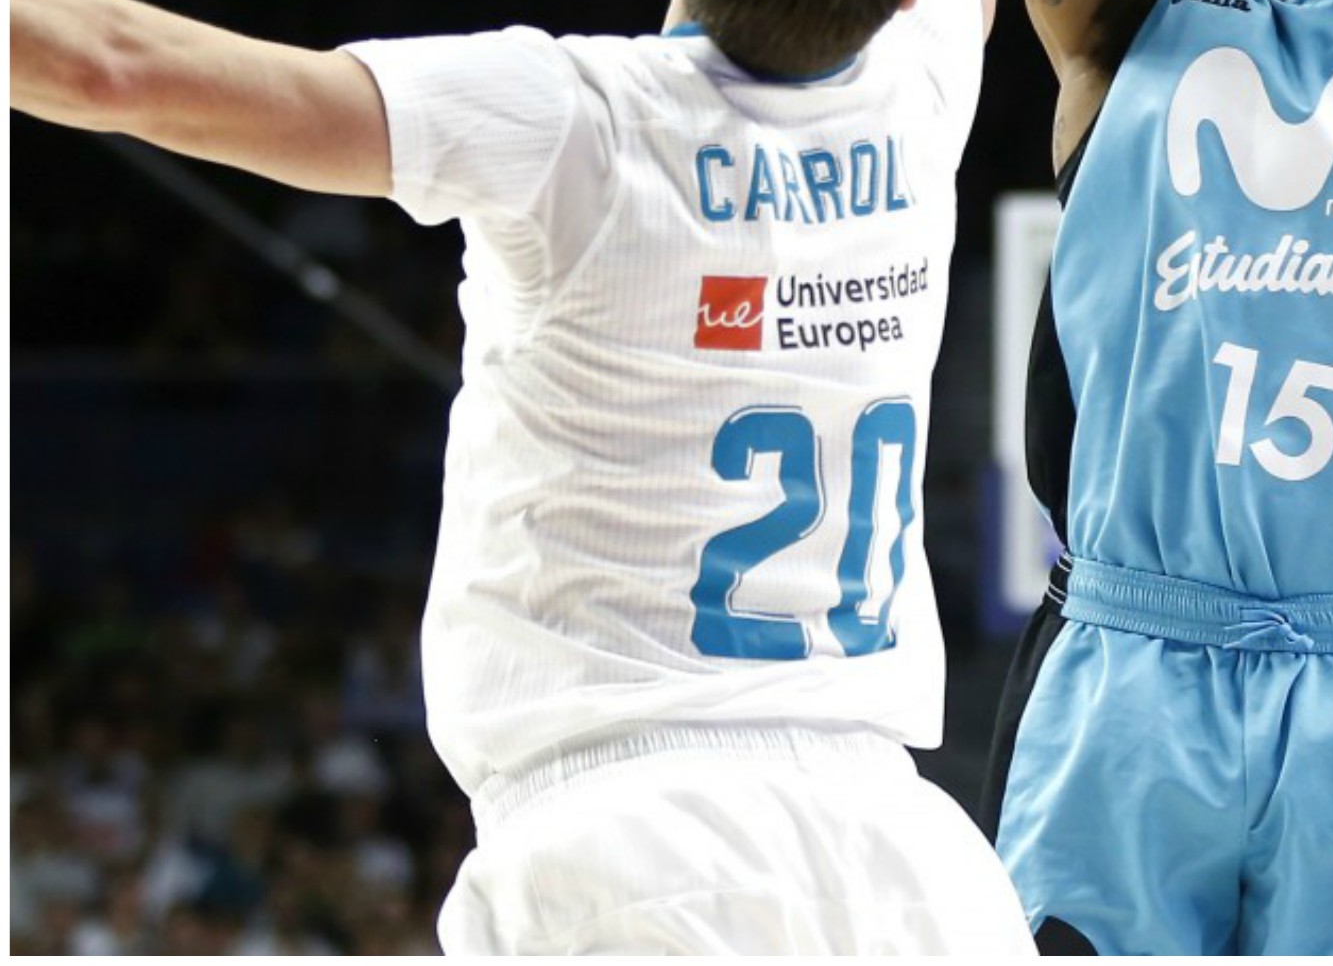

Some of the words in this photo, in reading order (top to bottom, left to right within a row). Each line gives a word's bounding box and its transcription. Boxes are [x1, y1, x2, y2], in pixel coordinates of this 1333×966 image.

[775, 257, 929, 308] Universidad
[775, 315, 905, 352] Europea
[690, 395, 918, 662] 20
